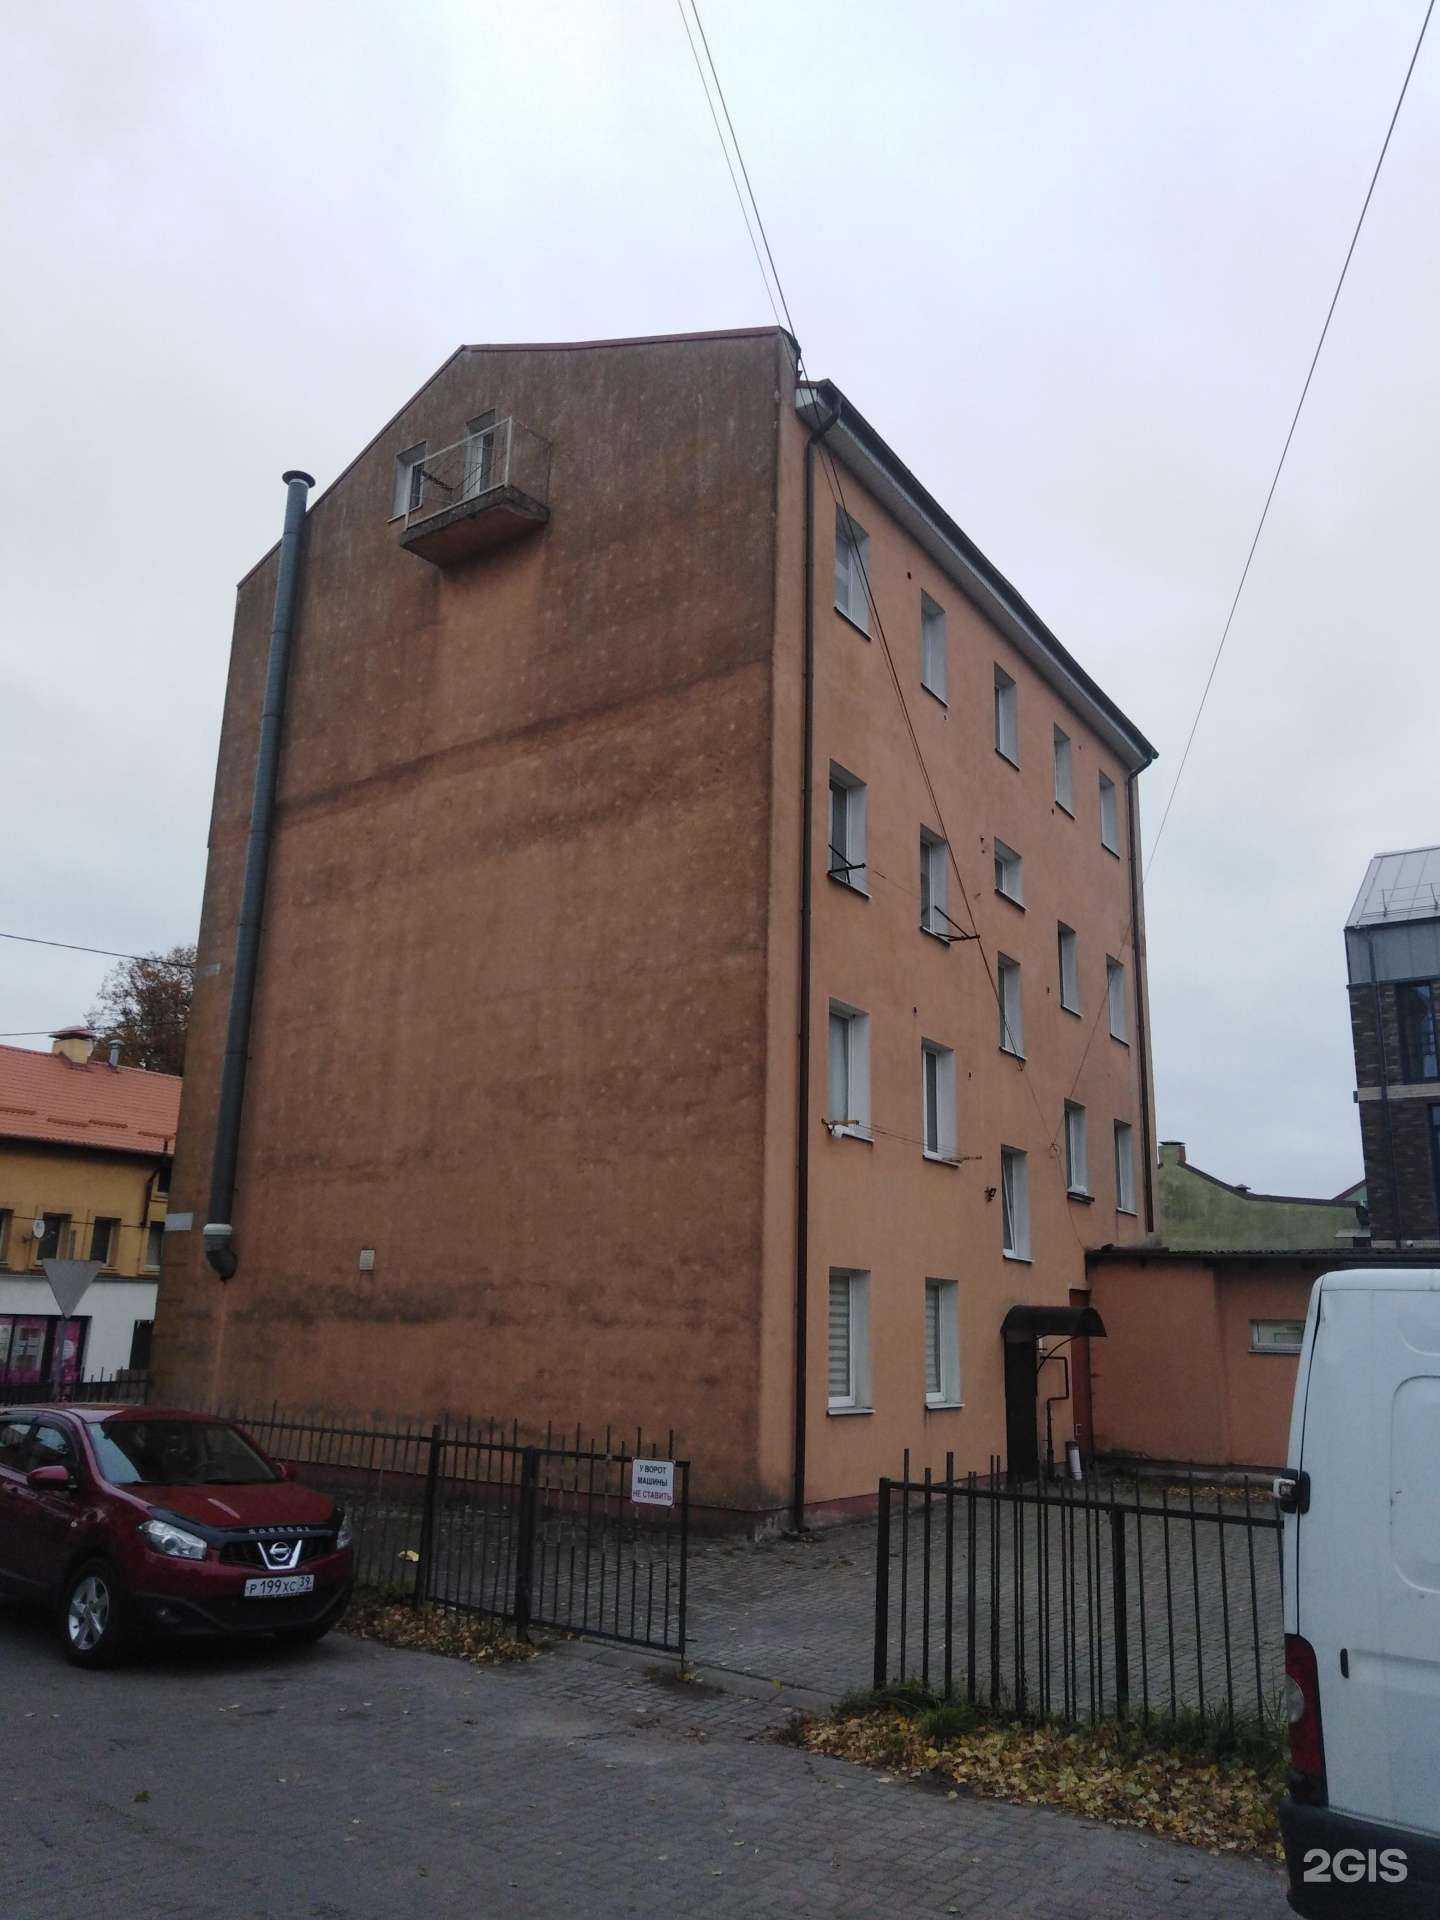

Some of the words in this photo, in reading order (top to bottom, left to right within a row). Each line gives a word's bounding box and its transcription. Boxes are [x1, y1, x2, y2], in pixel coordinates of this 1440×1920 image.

[644, 1465, 666, 1474] ВОРОТ
[637, 1476, 668, 1487] МАШИНЫ
[632, 1490, 641, 1498] НЕ
[642, 1490, 672, 1501] СТАВИТЬ
